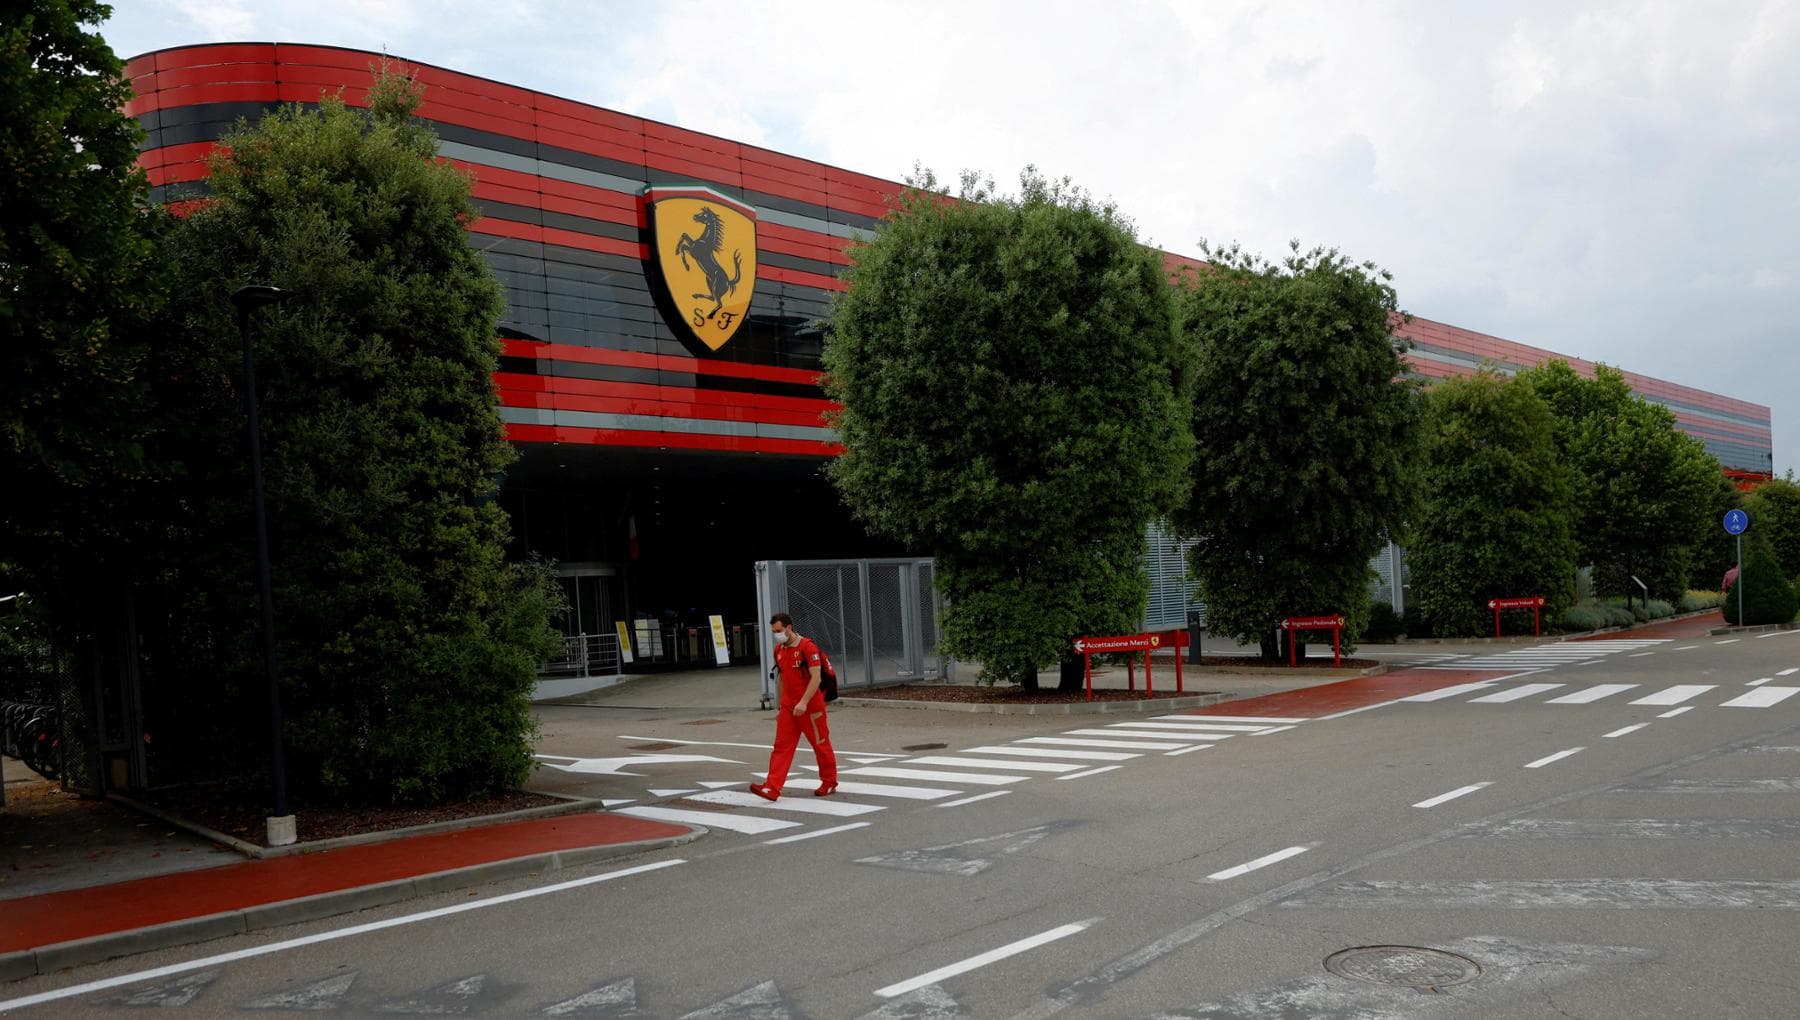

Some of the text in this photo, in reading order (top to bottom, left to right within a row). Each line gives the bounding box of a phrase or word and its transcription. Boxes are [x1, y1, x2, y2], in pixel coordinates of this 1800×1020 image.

[693, 307, 739, 330] S F
[1086, 638, 1149, 649] Accettazione Merci
